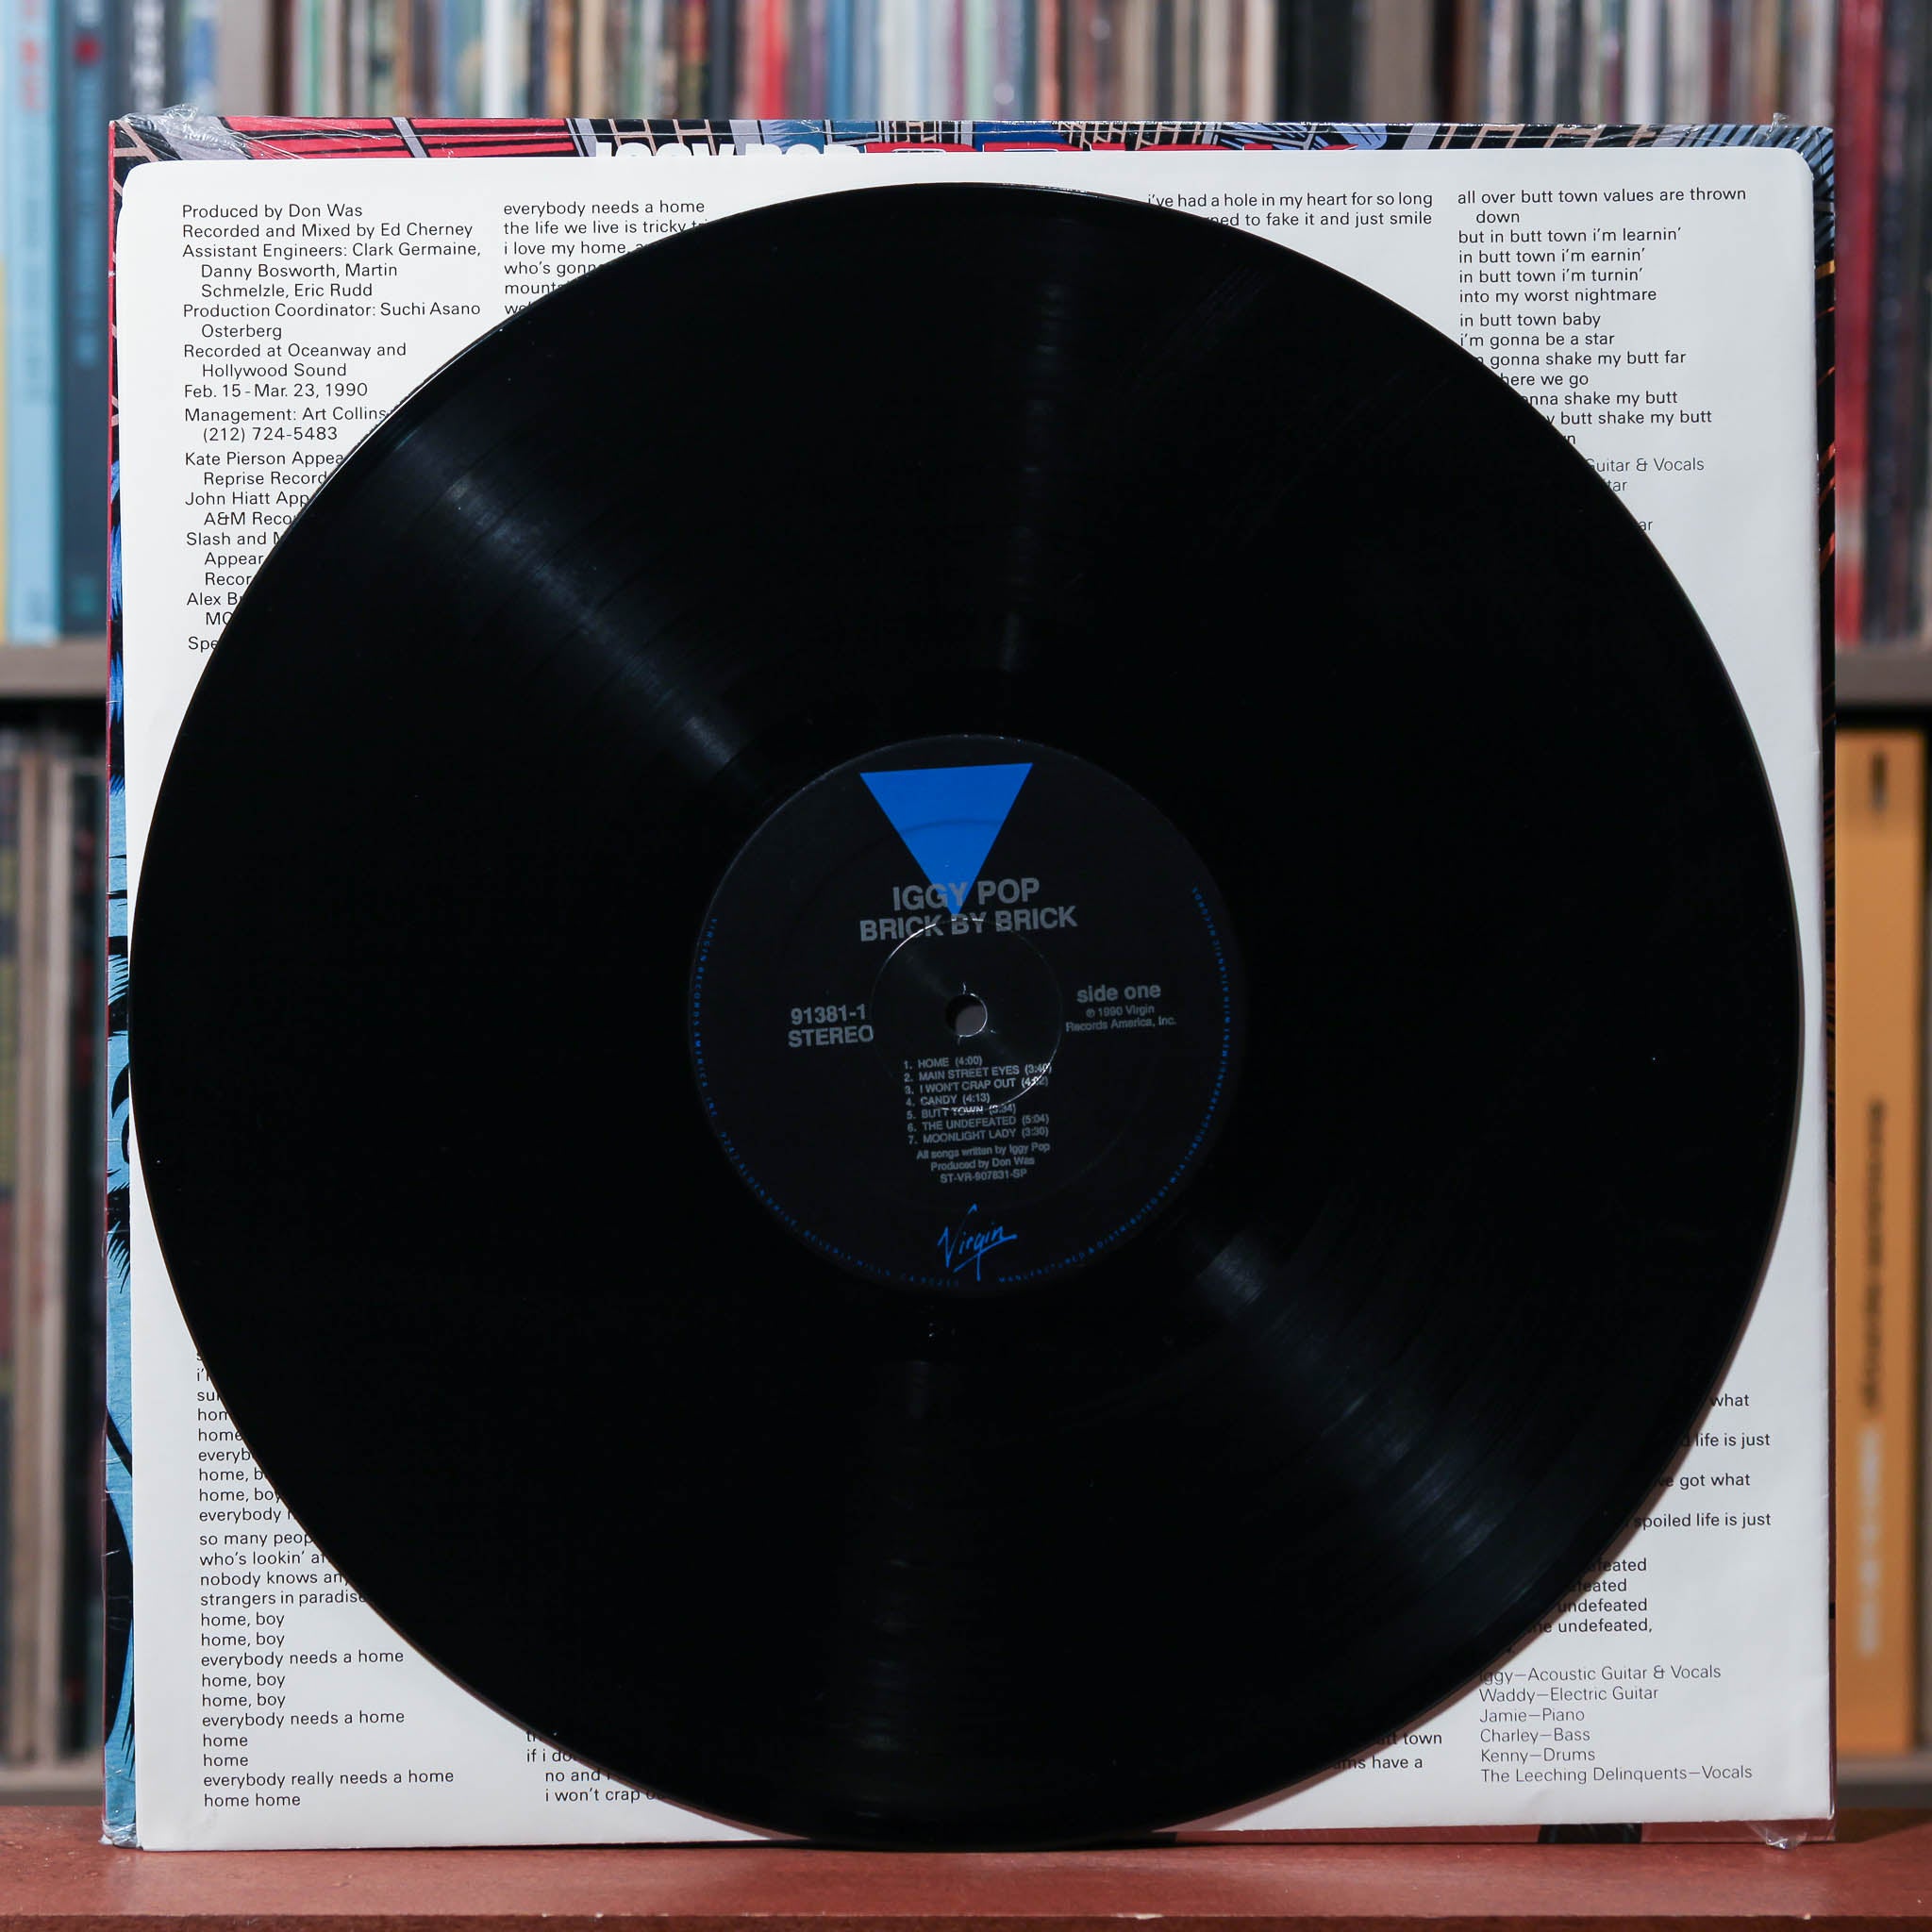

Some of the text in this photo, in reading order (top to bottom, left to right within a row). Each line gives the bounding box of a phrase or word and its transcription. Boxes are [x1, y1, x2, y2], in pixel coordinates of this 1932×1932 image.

[1178, 193, 1207, 207] had
[1211, 197, 1219, 207] a
[1224, 193, 1257, 207] hole
[1262, 193, 1274, 206] in
[1280, 196, 1303, 208] my
[1307, 192, 1347, 206] heart
[1351, 192, 1374, 206] for
[1376, 194, 1394, 206] so
[1399, 192, 1432, 208] long
[1458, 187, 1745, 204] all over butt town values are thrown
[183, 204, 362, 220] Produced by Don Was
[504, 200, 704, 218] everybody needs a home
[1476, 210, 1519, 224] down
[183, 223, 473, 239] Recorded and Mixed by Ed Cherney
[504, 222, 528, 234] the
[536, 221, 558, 234] life
[564, 225, 587, 234] we
[593, 221, 618, 233] live
[625, 220, 637, 233] is
[183, 242, 480, 260] Assistant Engineers: Clark Germaine,
[202, 263, 396, 280] Danny Bosworth, Martin
[202, 284, 372, 298] Schmelzle, Eric Rudd
[1460, 288, 1657, 306] into my worst nightmare
[184, 302, 480, 317] Production Coordinator: Suchi Asano
[202, 325, 281, 341] Osterberg
[185, 342, 406, 359] Recorded at Oceanway and
[203, 363, 346, 380] Hollywood Sound
[185, 385, 216, 398] Feb.
[223, 384, 241, 397] 15
[294, 384, 319, 398] 23,
[326, 383, 367, 396] 1990
[186, 408, 296, 425] Management:
[302, 408, 326, 420] Art
[204, 426, 337, 443] (212) 724-5483
[204, 512, 245, 525] A&M
[892, 877, 1041, 911] IGGY POP
[860, 906, 1078, 941] BRICK BY BRICK
[1076, 985, 1161, 1004] side one
[791, 1004, 868, 1025] 91381-1
[1098, 1005, 1155, 1017] 1990 Virgin
[1065, 1016, 1176, 1032] Records America, Inc.
[788, 1024, 874, 1048] STEREO
[904, 1056, 983, 1069] 1. HOME (4:00)
[904, 1065, 1019, 1082] 2. MAIN STREET EYES
[925, 1083, 958, 1093] WON'T
[961, 1080, 991, 1091] CRAP
[994, 1078, 1016, 1089] OUT
[906, 1092, 991, 1107] 4. CANDY (4:13)
[922, 1108, 948, 1119] BUTT
[952, 1106, 983, 1117] TOWN
[908, 1113, 1049, 1132] 6. THE UNDEFEATED (5:04)
[908, 1126, 1049, 1144] 7. MOONLIGHT LADY (3:30)
[917, 1141, 1050, 1159] All songs written by Iggy Pop
[930, 1157, 1035, 1171] Produced by Don Was
[937, 1204, 1018, 1282] Virgin
[1680, 1473, 1750, 1490] got what
[1697, 1512, 1771, 1529] life is just
[1558, 1618, 1652, 1633] undefeated,
[1602, 1666, 1647, 1680] Guitar
[1654, 1665, 1665, 1679] &
[1671, 1665, 1721, 1678] Vocals
[1613, 1686, 1658, 1700] Guitar
[203, 1709, 404, 1729] everybody needs a home
[1481, 1769, 1509, 1782] The
[1517, 1769, 1586, 1785] Leeching
[205, 1793, 300, 1807] home home
